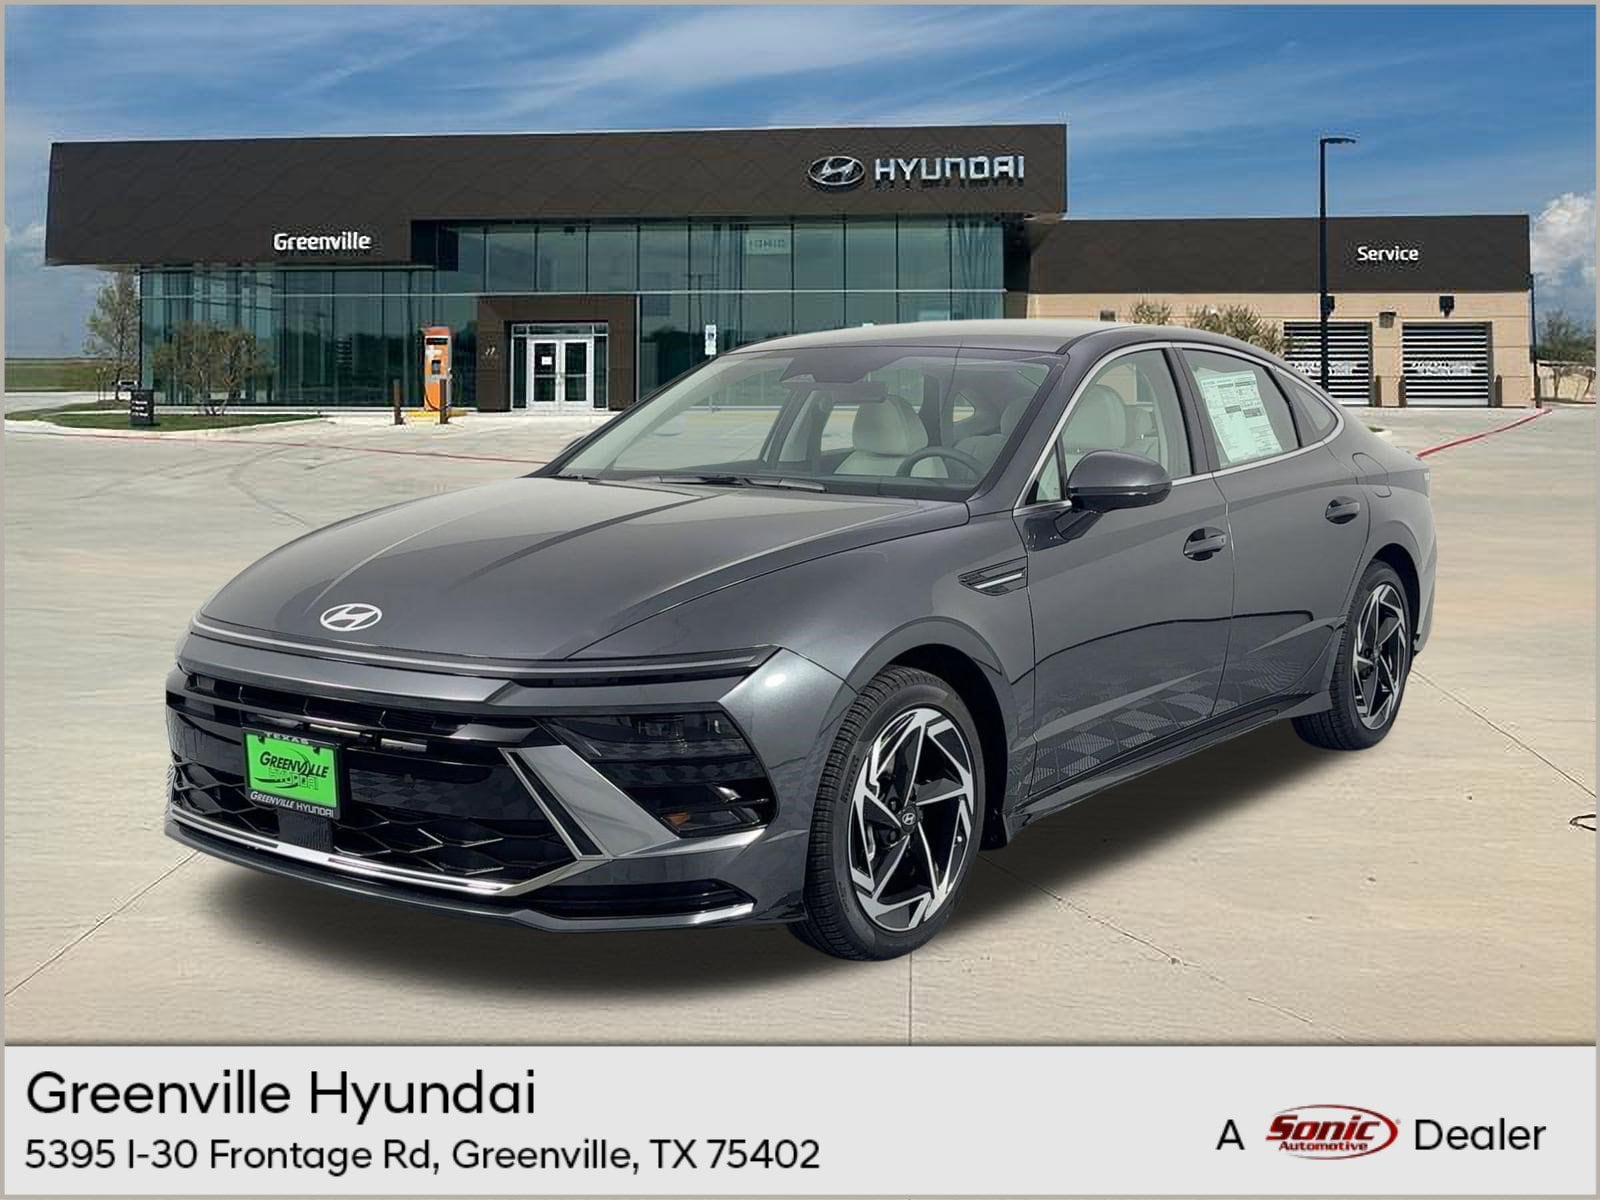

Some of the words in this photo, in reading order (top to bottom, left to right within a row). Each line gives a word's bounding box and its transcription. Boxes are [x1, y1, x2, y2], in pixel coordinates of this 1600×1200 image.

[875, 155, 1025, 181] HYUNDAI
[273, 231, 372, 251] Greenville
[1356, 244, 1420, 262] Service
[265, 731, 309, 745] TEXAS
[259, 751, 329, 778] GREENVILLE
[250, 791, 295, 809] GREENVILLE
[295, 801, 335, 818] HYUNDAI
